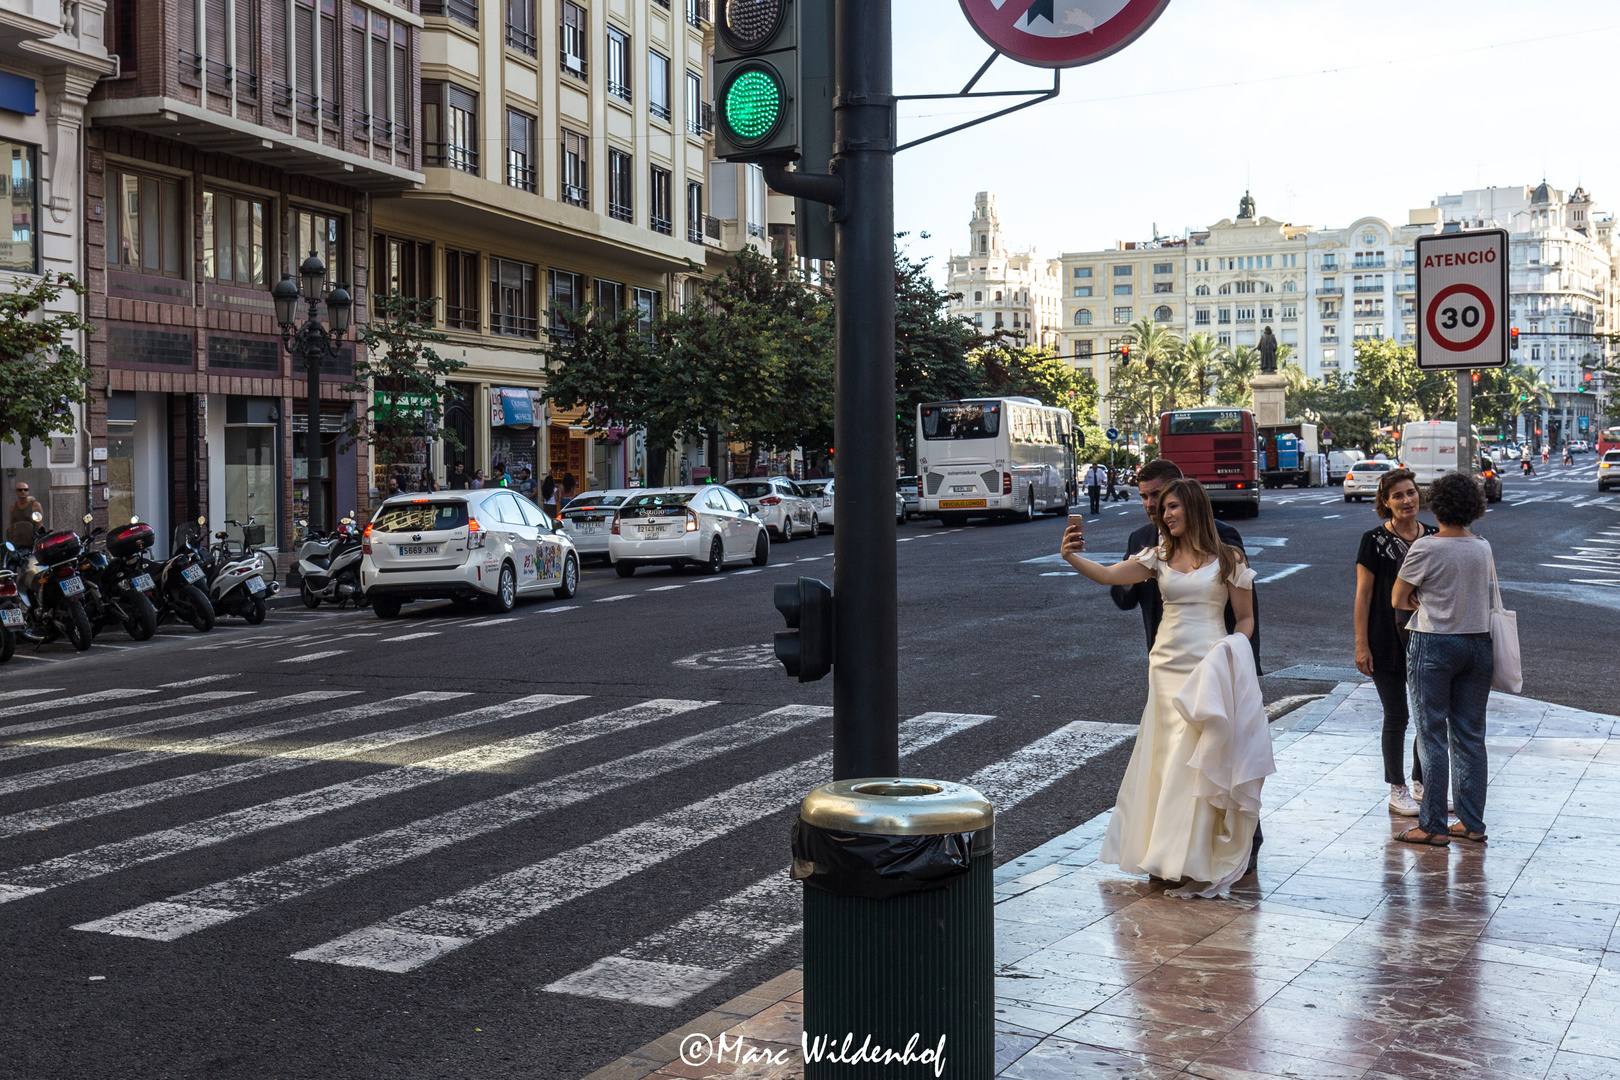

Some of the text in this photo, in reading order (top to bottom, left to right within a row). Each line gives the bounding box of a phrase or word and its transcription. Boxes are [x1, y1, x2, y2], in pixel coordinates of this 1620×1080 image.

[1424, 247, 1496, 268] ATENCIÓ
[1441, 305, 1480, 330] 30
[424, 545, 438, 554] JNX
[65, 577, 80, 587] 0001
